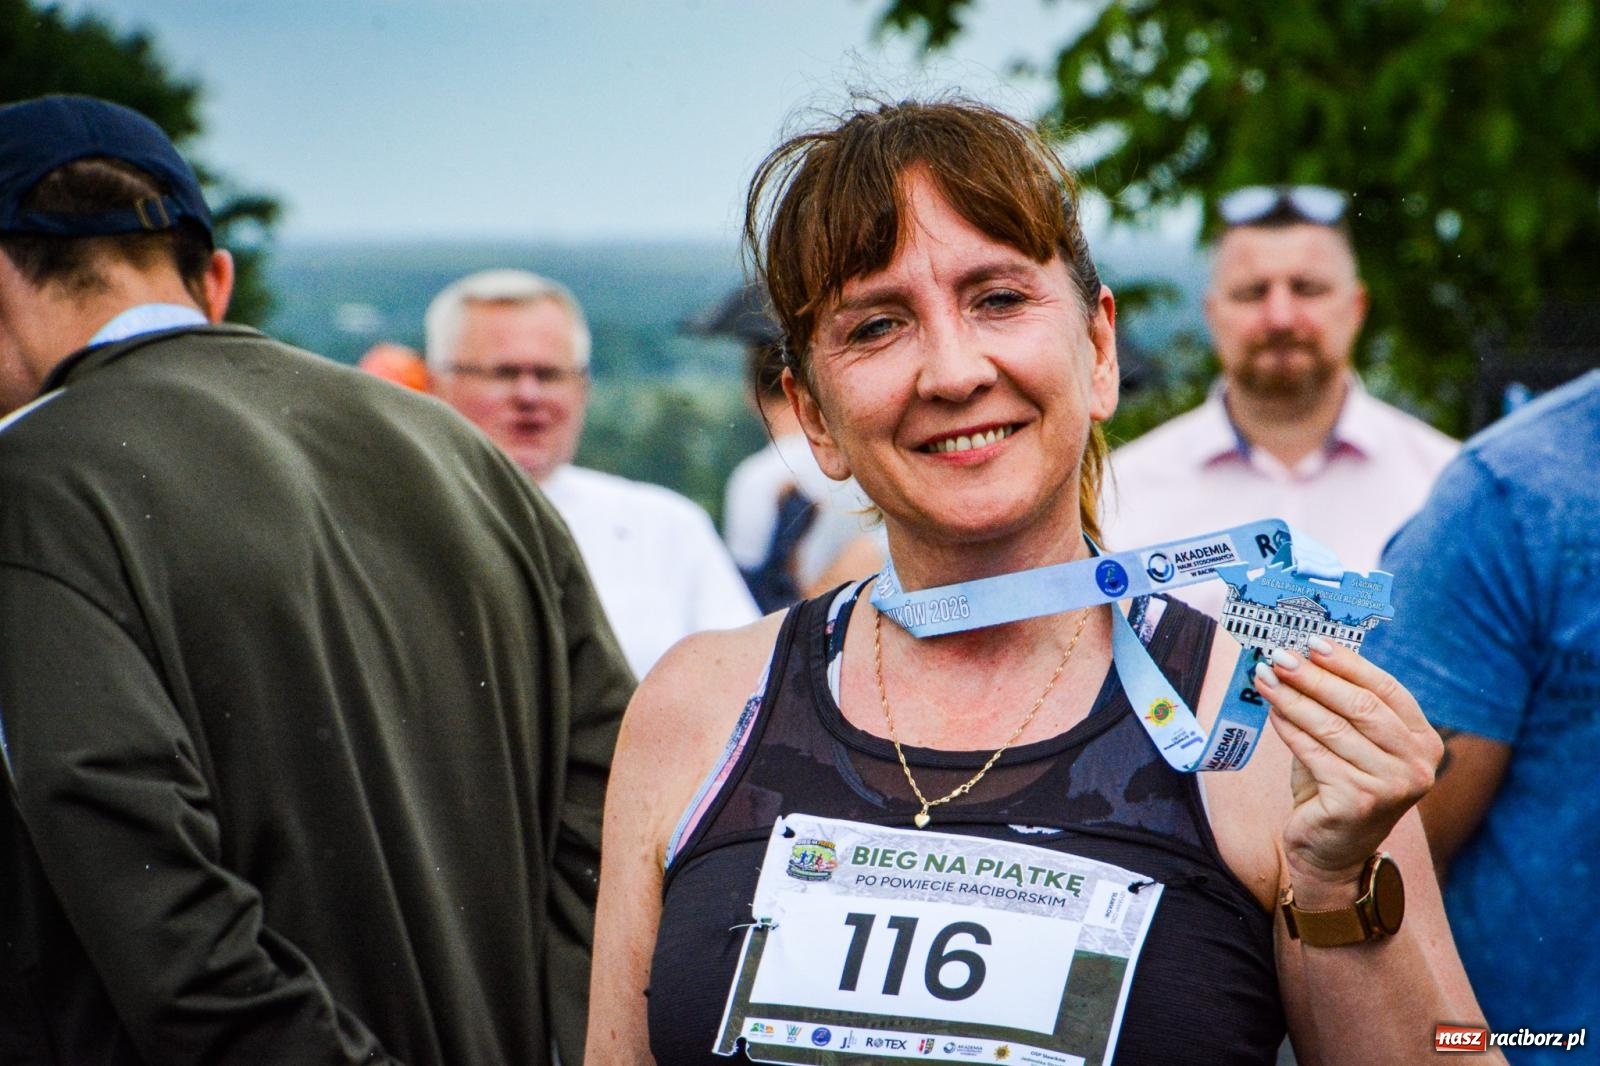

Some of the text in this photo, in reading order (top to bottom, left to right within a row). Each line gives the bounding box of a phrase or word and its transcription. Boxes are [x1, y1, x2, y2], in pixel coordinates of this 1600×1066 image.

[1174, 543, 1231, 563] AKADEMIA
[930, 595, 970, 624] 2026
[851, 846, 1085, 897] BIEG NA PIĄTKĘ
[855, 874, 1066, 908] PO POWIECIE RACIBORSKIM
[838, 912, 992, 1002] 116
[866, 1037, 907, 1050] ROTEX
